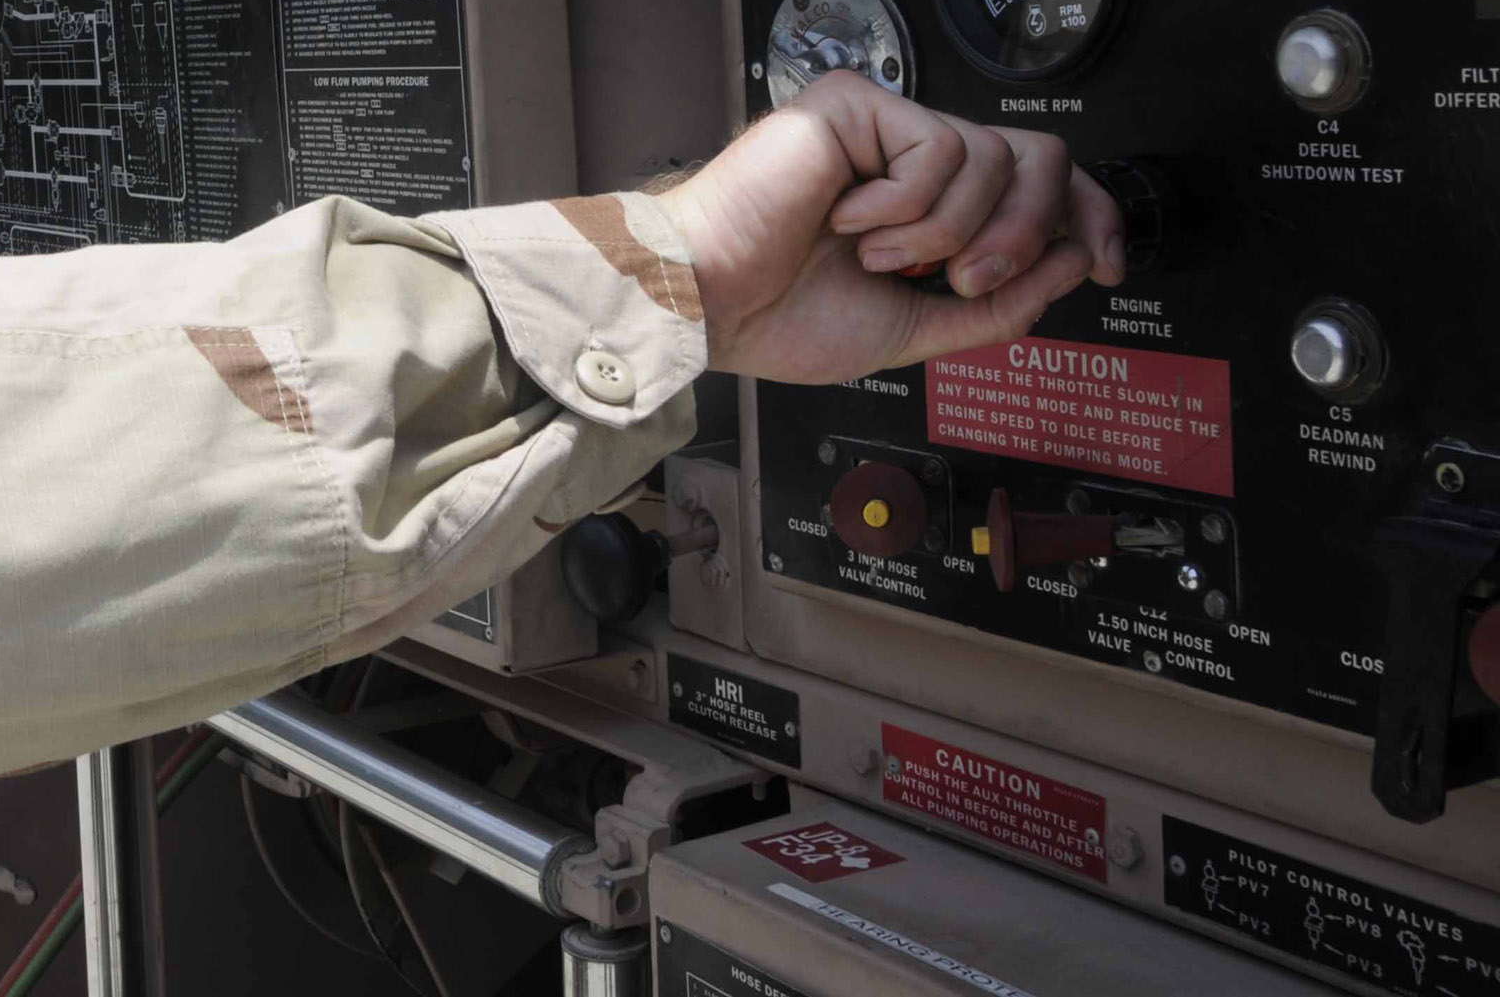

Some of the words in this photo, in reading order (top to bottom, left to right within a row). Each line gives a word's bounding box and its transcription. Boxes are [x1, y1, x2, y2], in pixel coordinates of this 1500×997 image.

[1060, 4, 1082, 16] RPM
[1061, 15, 1086, 27] x100
[314, 78, 329, 86] LOW
[331, 78, 350, 86] FLOW
[352, 77, 384, 86] PUMPING
[386, 76, 429, 86] PROCEDURE
[1461, 68, 1500, 83] FILT
[1001, 99, 1048, 112] ENGINE
[1052, 100, 1082, 112] RPM
[1317, 120, 1339, 134] C4
[1299, 143, 1361, 159] DEFUEL
[1262, 165, 1355, 182] SHUTDOWN
[1361, 168, 1404, 183] TEST
[1111, 297, 1162, 315] ENGINE
[1102, 317, 1172, 337] THROTTLE
[1009, 344, 1128, 382] CAUTION
[864, 378, 909, 397] REWIND
[936, 362, 1001, 382] INCREASE
[1008, 372, 1032, 386] THE
[1039, 376, 1110, 398] THROTTLE
[1118, 387, 1179, 408] SLOWLY
[1187, 397, 1202, 412] IN
[937, 383, 962, 397] ANY
[968, 387, 1030, 408] PUMPING
[1036, 398, 1077, 415] MODE
[1084, 406, 1113, 421] AND
[1121, 411, 1182, 432] REDUCE
[1190, 421, 1220, 438] THE
[1329, 405, 1352, 422] C5
[938, 404, 984, 422] ENGINE
[991, 412, 1034, 430] SPEED
[1040, 419, 1058, 434] TO
[1064, 424, 1096, 440] IDLE
[1103, 430, 1162, 452] BEFORE
[1300, 424, 1384, 451] DEADMAN
[938, 424, 1006, 446] CHANGING
[1012, 436, 1038, 452] THE
[1044, 441, 1111, 465] PUMPING
[1118, 454, 1168, 475] MODE.
[1309, 449, 1376, 472] REWIND
[788, 518, 827, 537] CLOSED
[848, 551, 854, 562] 3
[859, 553, 884, 569] INCH
[888, 561, 918, 578] HOSE
[943, 556, 974, 573] OPEN
[839, 565, 872, 585] VALVE
[876, 576, 926, 599] CONTROL
[1027, 575, 1077, 599] CLOSED
[1097, 613, 1128, 632] 1.50
[1134, 621, 1168, 641] INCH
[1173, 632, 1213, 653] HOSE
[1229, 624, 1270, 646] OPEN
[1088, 630, 1131, 653] VALVE
[1166, 651, 1235, 681] CONTROL
[688, 701, 726, 722] CLUTCH
[730, 716, 777, 741] RELEASE
[710, 696, 736, 714] HOSE
[741, 707, 767, 724] REEL
[935, 749, 1041, 800] CAUTION
[905, 761, 939, 782] PUSH
[944, 774, 969, 793] THE
[973, 787, 1000, 804] AUX
[1004, 796, 1078, 833] THROTTLE
[885, 771, 942, 800] CONTROL
[946, 790, 960, 804] IN
[964, 797, 1017, 827] BEFORE
[1022, 820, 1052, 839] AND
[1057, 832, 1104, 859] AFTER
[901, 790, 923, 808] ALL
[927, 800, 988, 833] PUMPING
[993, 827, 1084, 868] OPERATIONS
[1229, 850, 1278, 877] PILOT
[1287, 870, 1373, 911] CONTROL
[1383, 903, 1463, 941] VALVES
[1238, 877, 1269, 897] PV7
[817, 904, 930, 959] HEARING
[1239, 913, 1271, 935] PV2
[1346, 916, 1382, 938] PV8
[1348, 954, 1382, 978] PV3
[731, 965, 762, 992] HOSE
